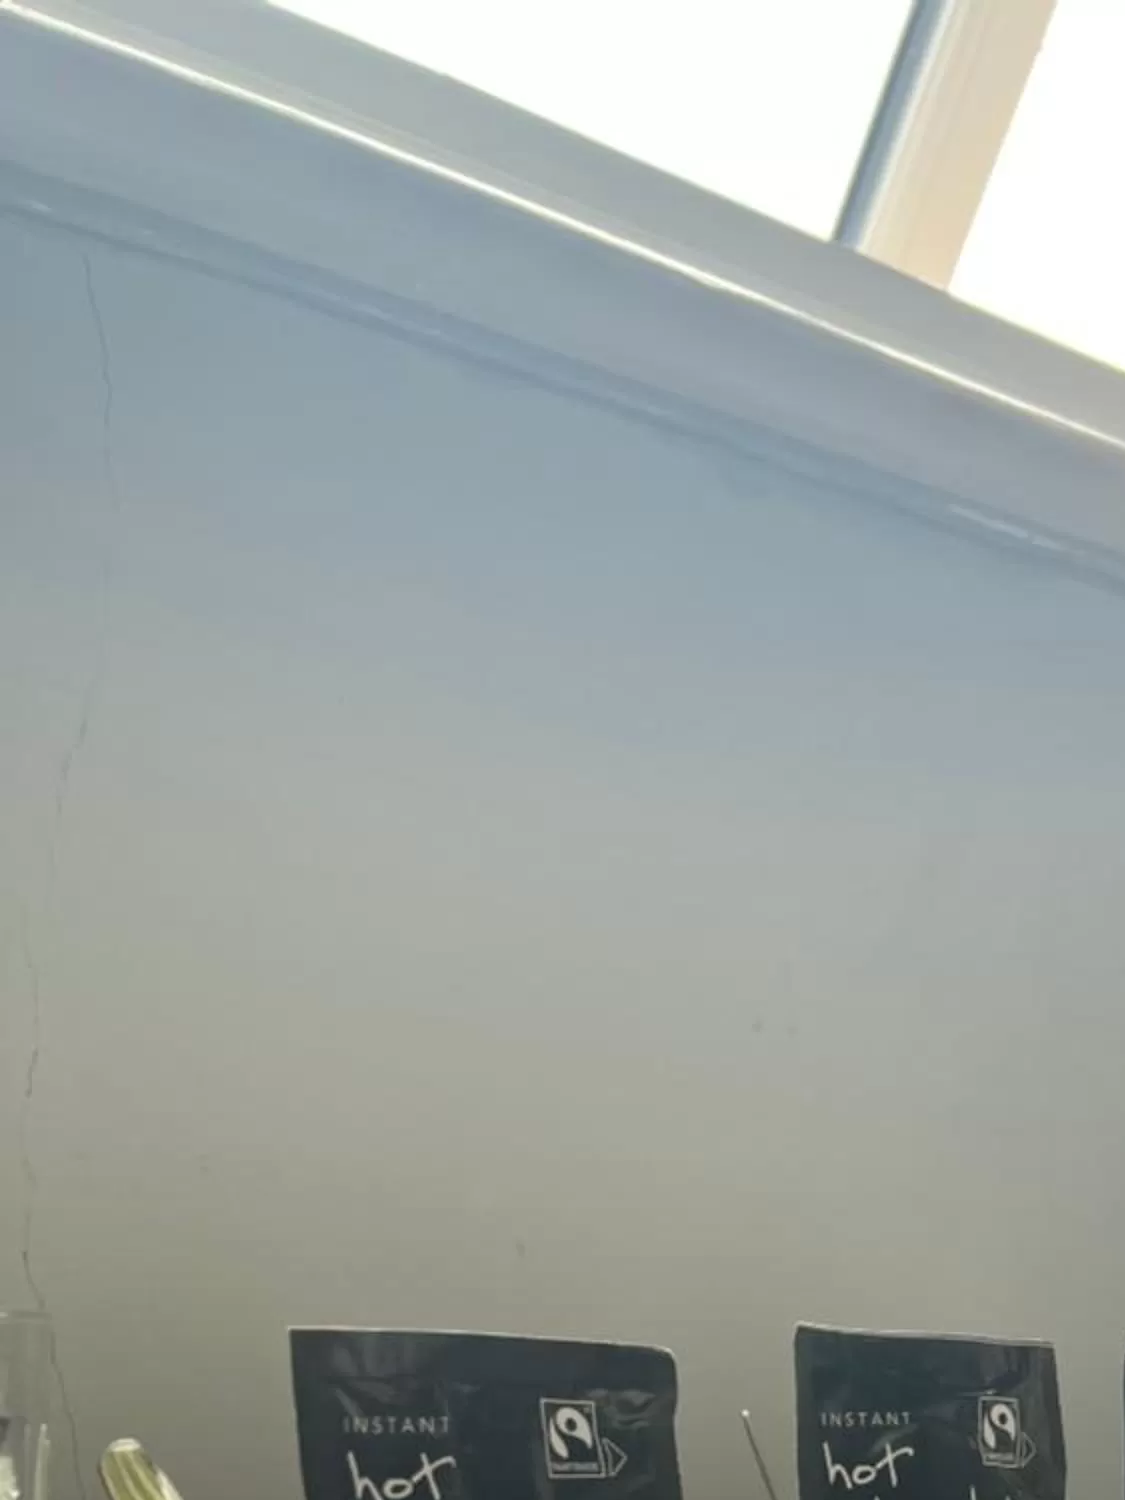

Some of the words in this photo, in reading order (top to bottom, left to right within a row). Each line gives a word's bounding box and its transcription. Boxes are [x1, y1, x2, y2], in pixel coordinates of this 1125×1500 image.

[343, 1416, 450, 1435] INSTANT
[821, 1411, 911, 1428] INSTANT
[823, 1442, 915, 1490] hot
